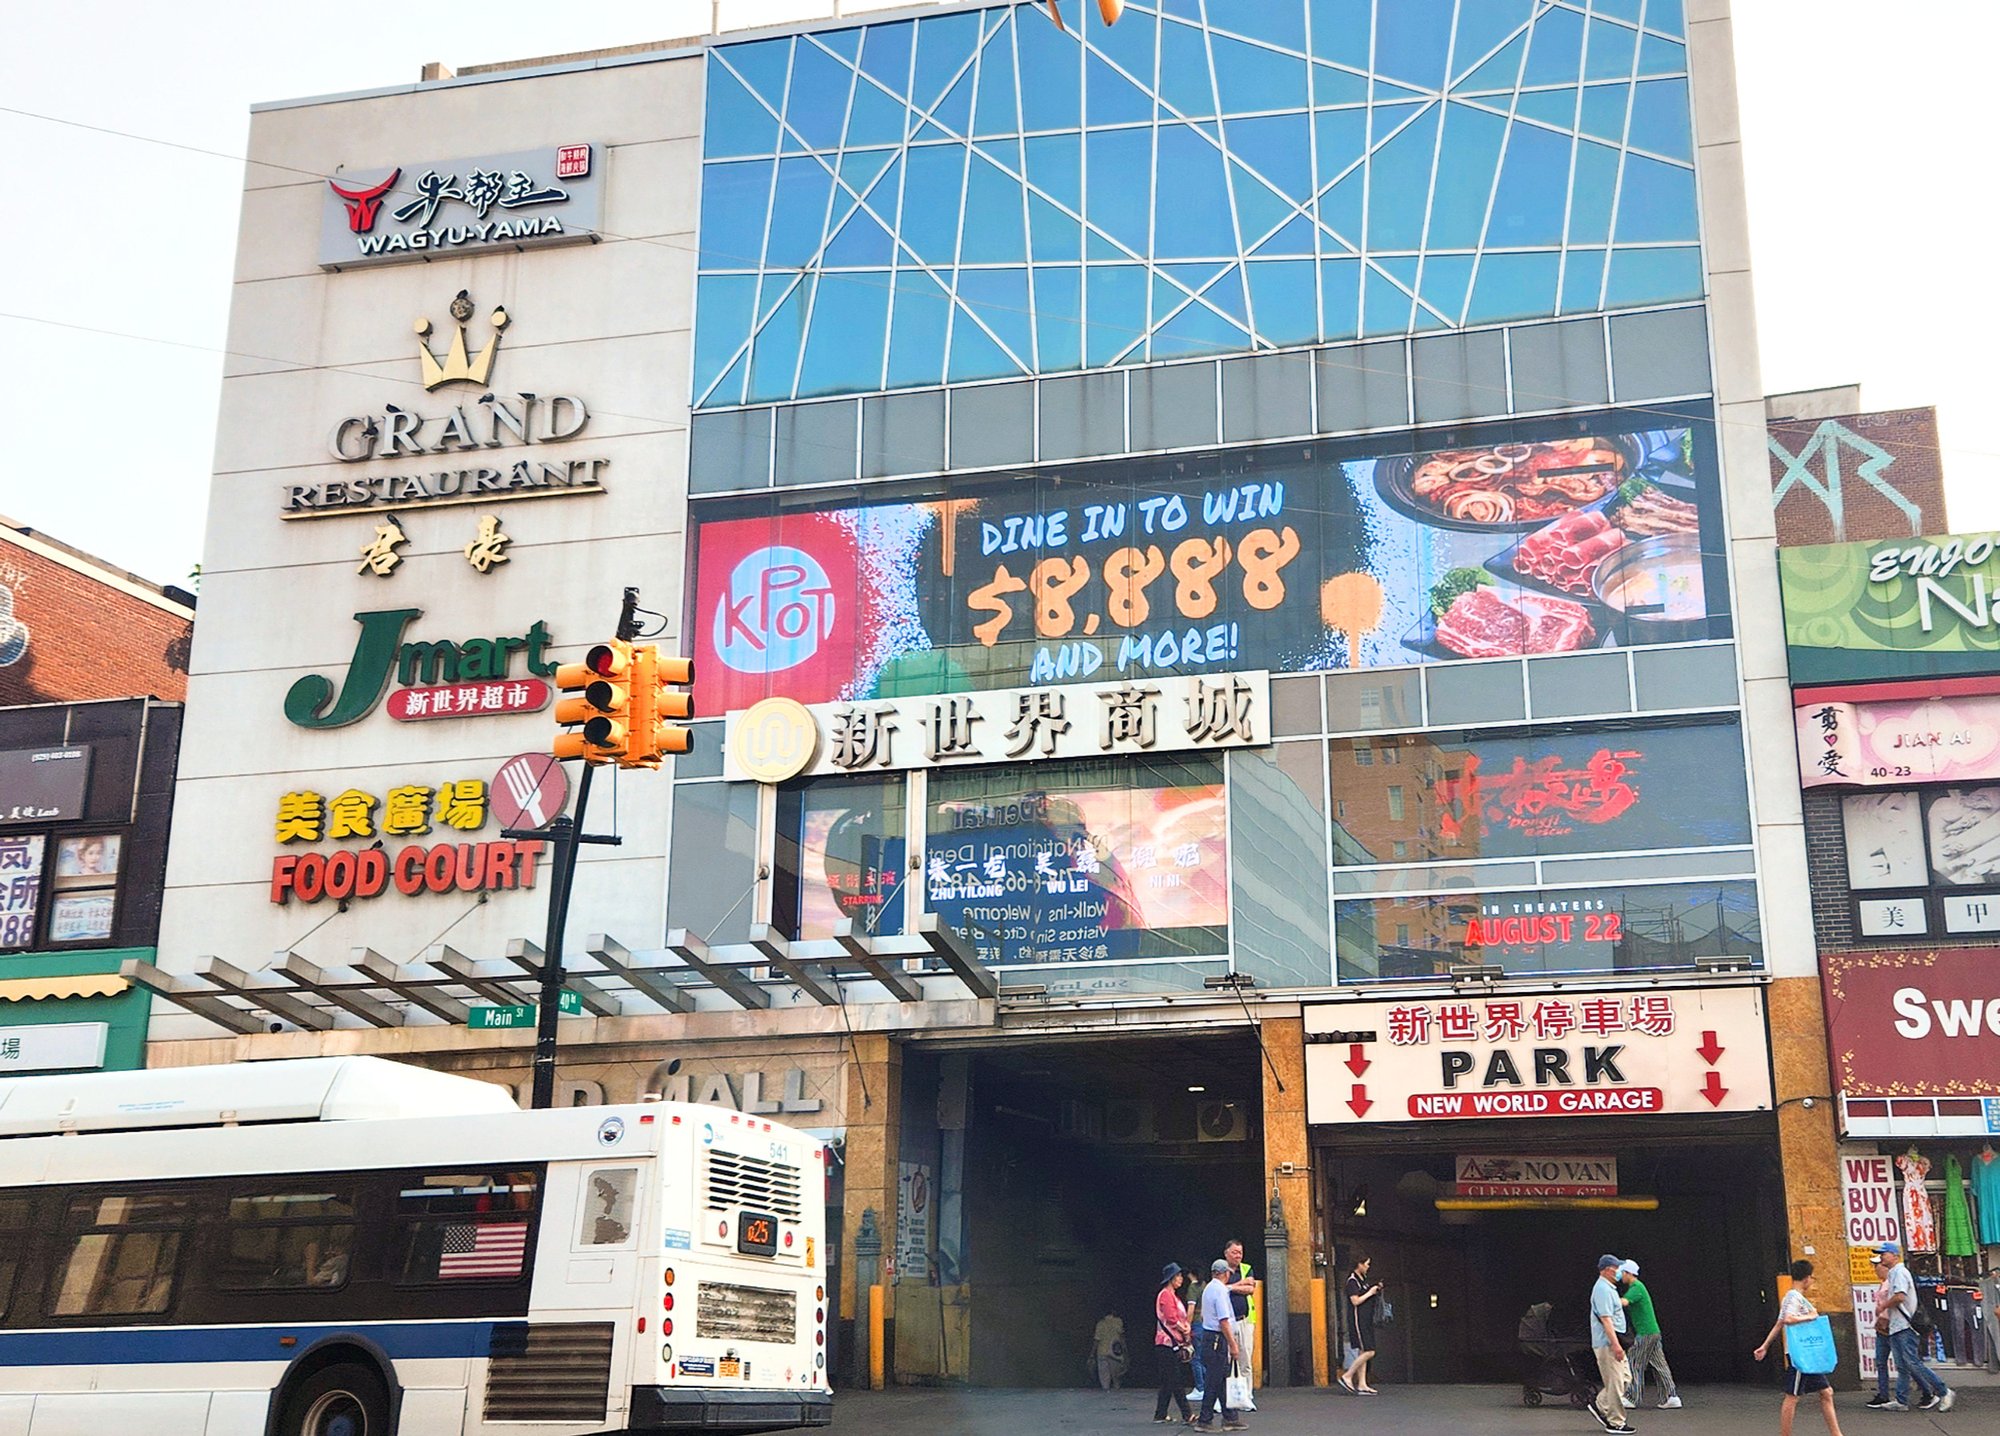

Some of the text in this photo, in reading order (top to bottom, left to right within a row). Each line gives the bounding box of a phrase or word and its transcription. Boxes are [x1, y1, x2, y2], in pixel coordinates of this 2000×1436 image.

[356, 215, 564, 256] WAGYU-YAMA
[328, 394, 590, 463] GRAND
[282, 457, 609, 511] RESTAURANT
[981, 481, 1285, 556] DINE IN TO WIN
[967, 525, 1301, 647] $8,888
[1917, 573, 2000, 632] N
[724, 565, 836, 650] KPOT
[1031, 623, 1240, 682] AND MORE!
[405, 683, 531, 716] 新世界超市
[831, 673, 1257, 768] 新世界商城
[1893, 731, 1943, 749] JIAN
[1870, 766, 1912, 778] 40-23
[275, 779, 489, 844] 美食廣場
[271, 840, 546, 904] FOOD COURT
[930, 886, 956, 901] ZHU
[958, 884, 1004, 900] YILONG
[1047, 880, 1066, 894] WU
[1070, 879, 1089, 893] LEI
[1482, 899, 1605, 917] IN THEATERS
[0, 914, 34, 945] 88
[1465, 913, 1624, 948] AUGUST 22
[485, 1008, 524, 1026] Main St
[560, 992, 570, 1010] 40
[1386, 995, 1676, 1046] 新世界停車場
[1440, 1044, 1629, 1089] PARK
[1416, 1089, 1654, 1115] NEW WORLD GARAGE
[1524, 1161, 1613, 1182] NO VAN
[1846, 1159, 1889, 1184] WE
[1468, 1185, 1566, 1197] CLEARANCE
[1848, 1187, 1893, 1214] BUY
[1849, 1217, 1898, 1242] GOLD
